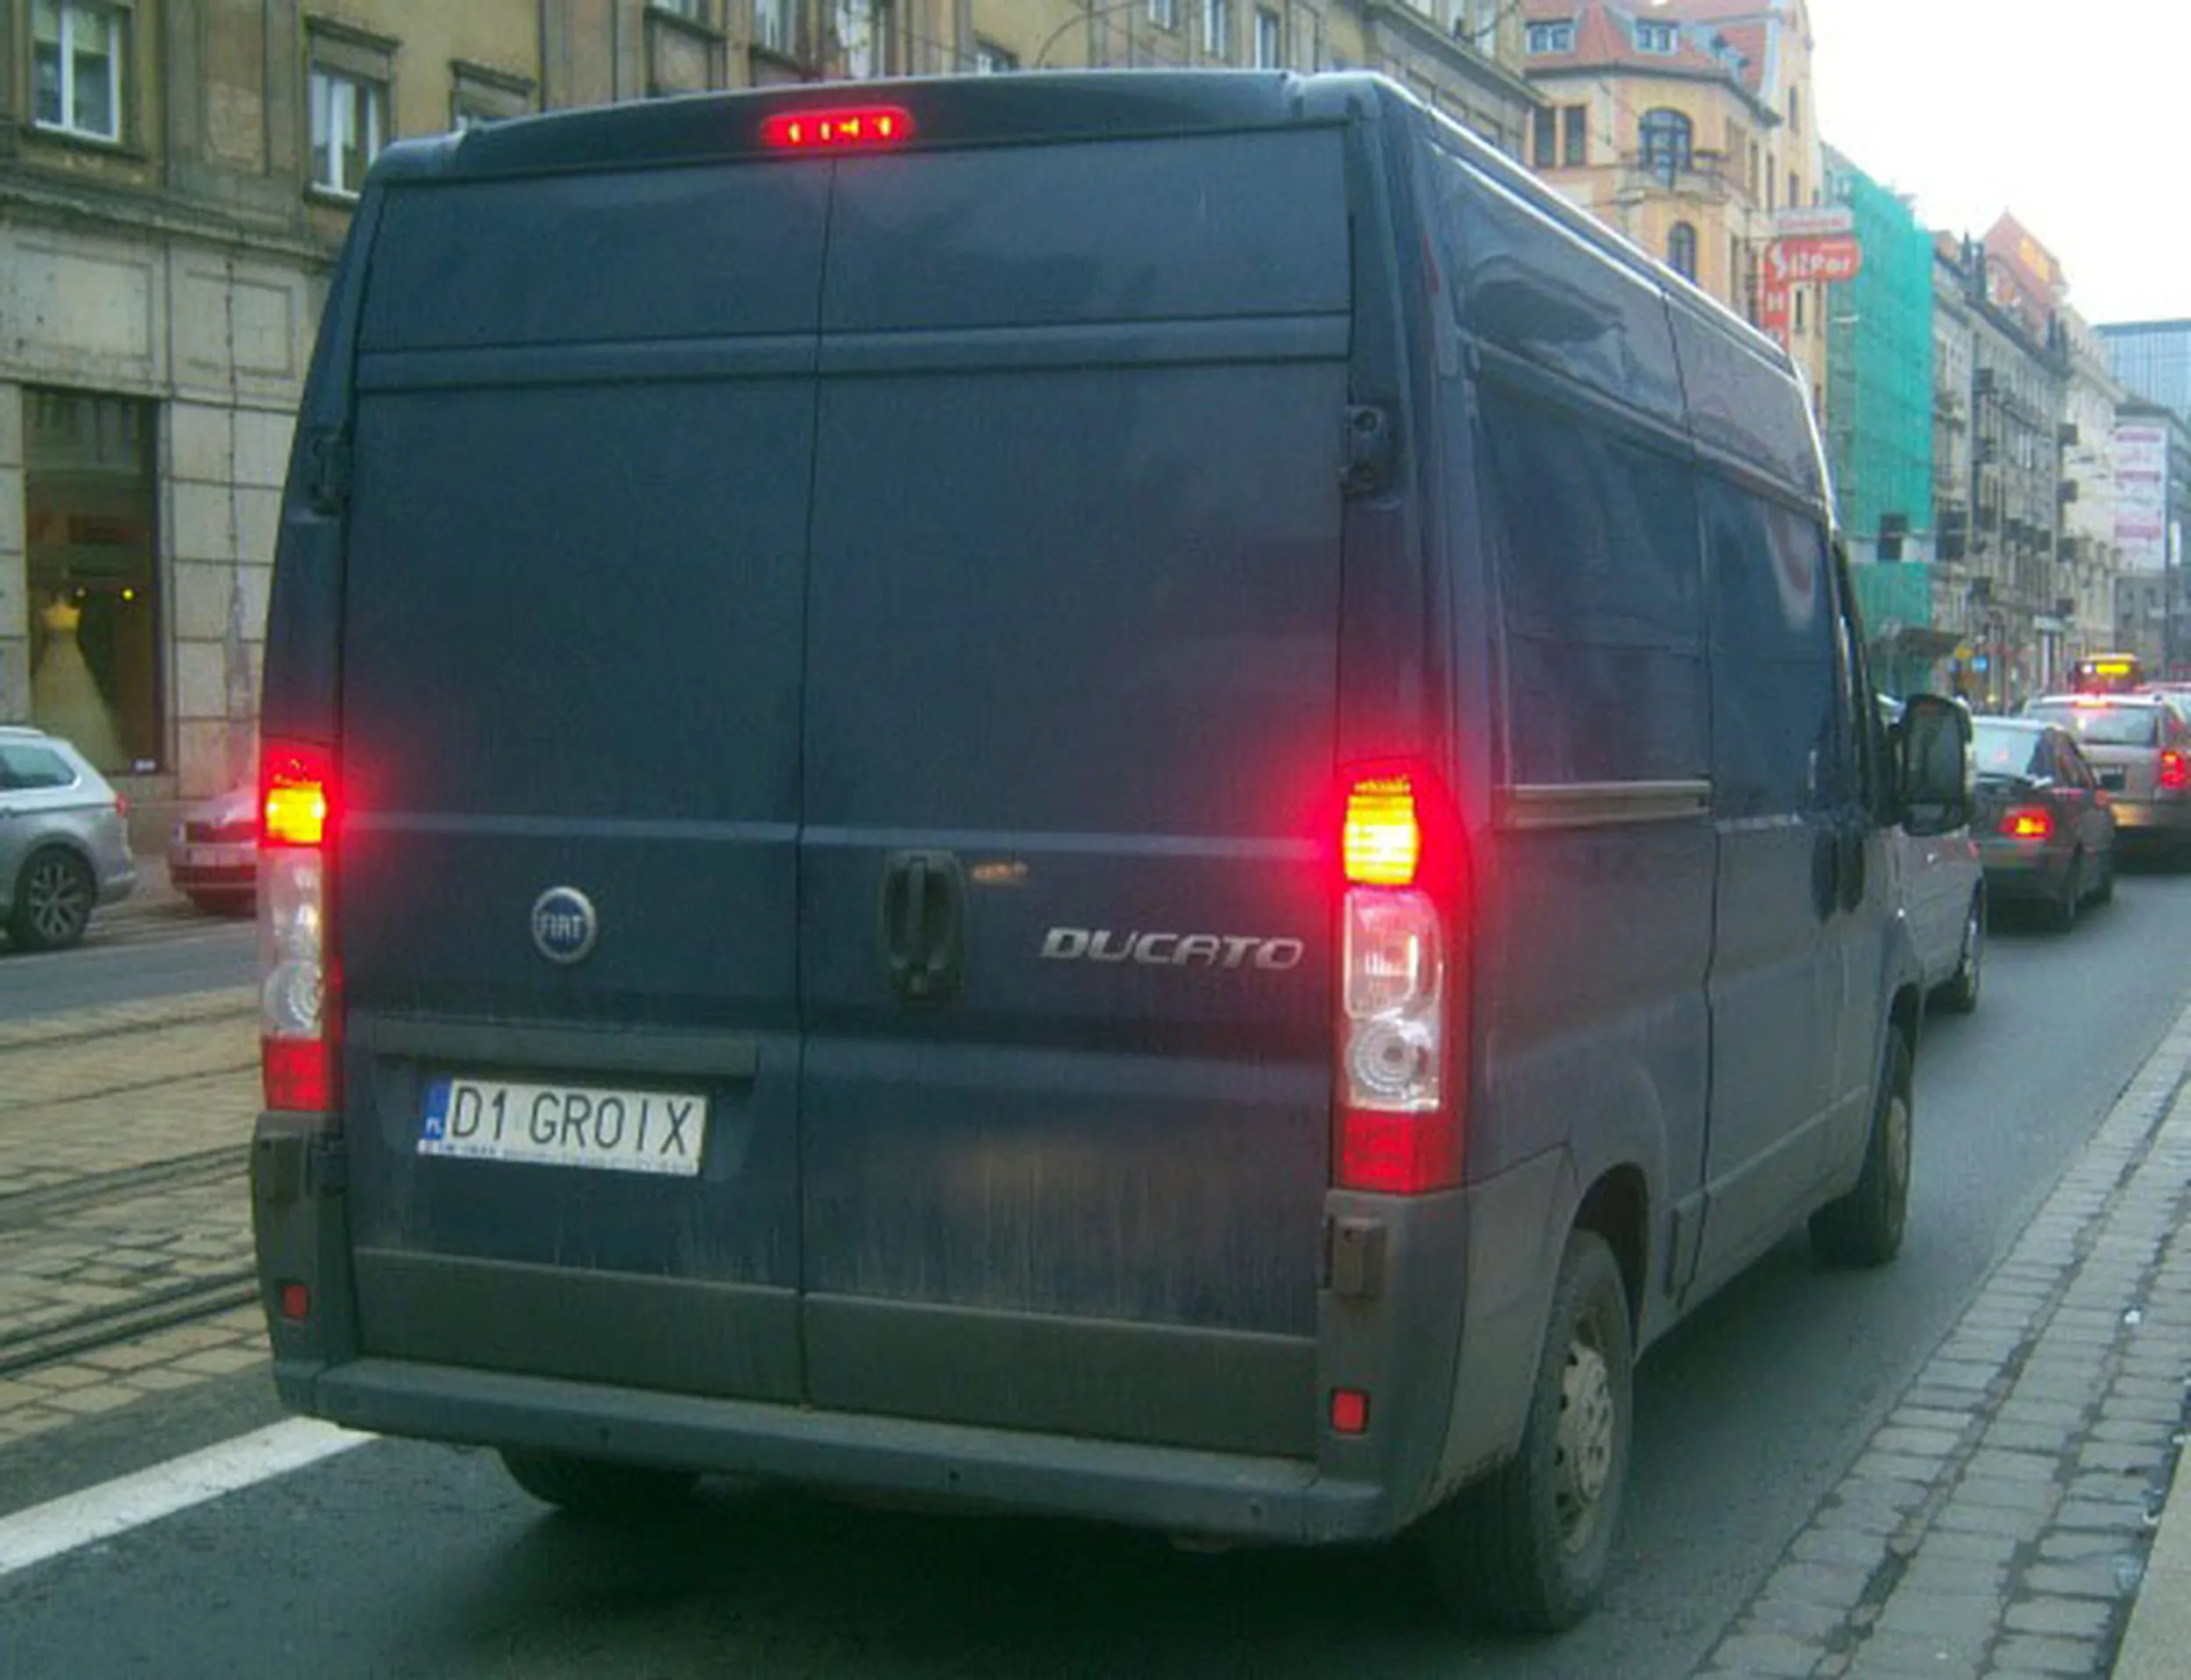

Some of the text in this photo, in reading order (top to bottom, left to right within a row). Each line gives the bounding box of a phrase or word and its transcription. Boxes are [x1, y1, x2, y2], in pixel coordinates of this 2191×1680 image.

[538, 913, 582, 940] FIAT
[1039, 926, 1306, 970] DUCATO
[451, 1086, 507, 1142] D1
